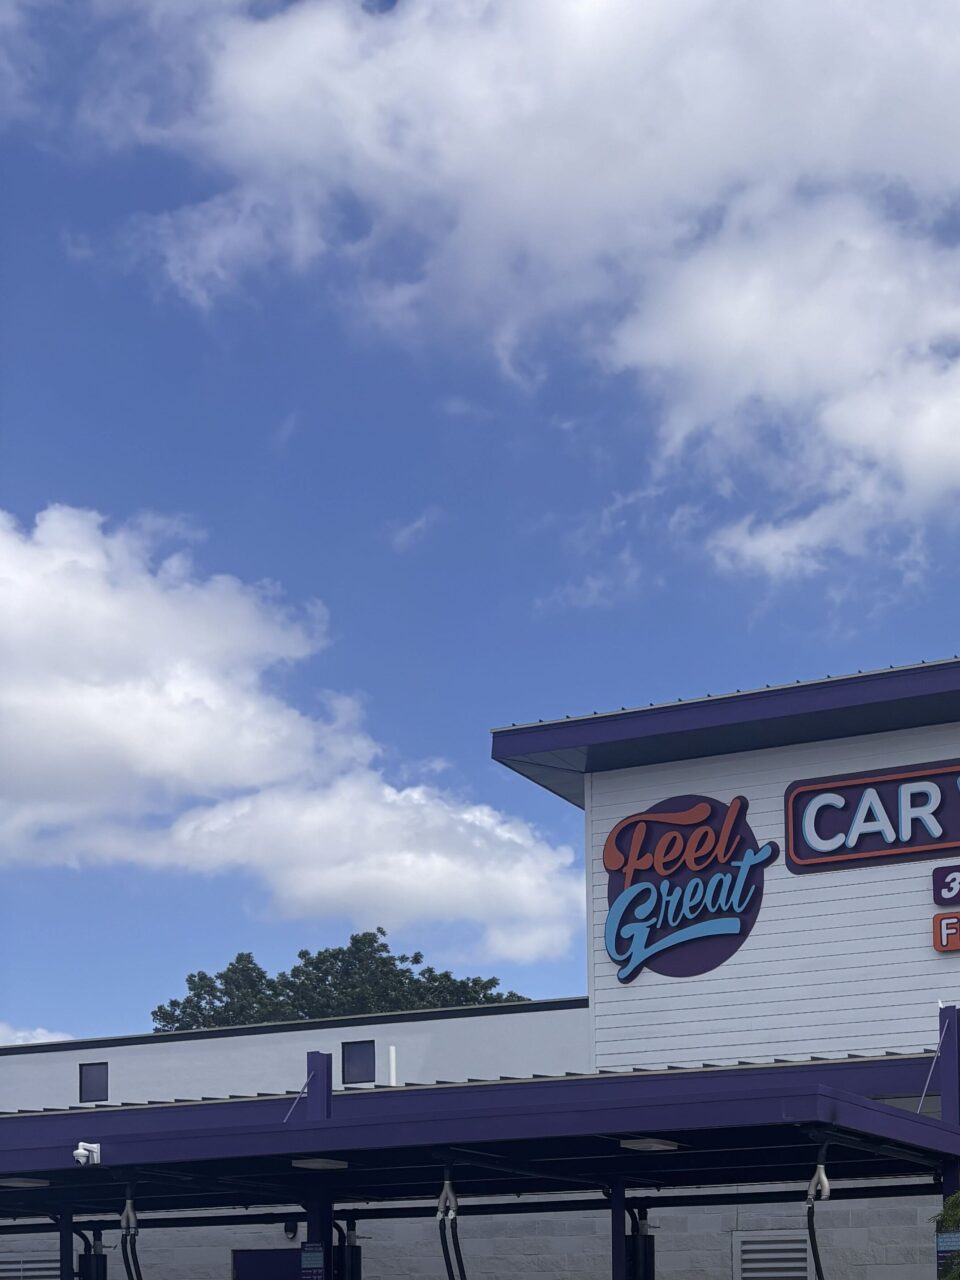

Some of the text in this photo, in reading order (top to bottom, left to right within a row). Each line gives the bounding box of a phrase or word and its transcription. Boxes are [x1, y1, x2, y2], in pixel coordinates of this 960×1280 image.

[603, 799, 744, 889] Feel
[802, 781, 943, 853] CAR
[604, 844, 772, 979] Great
